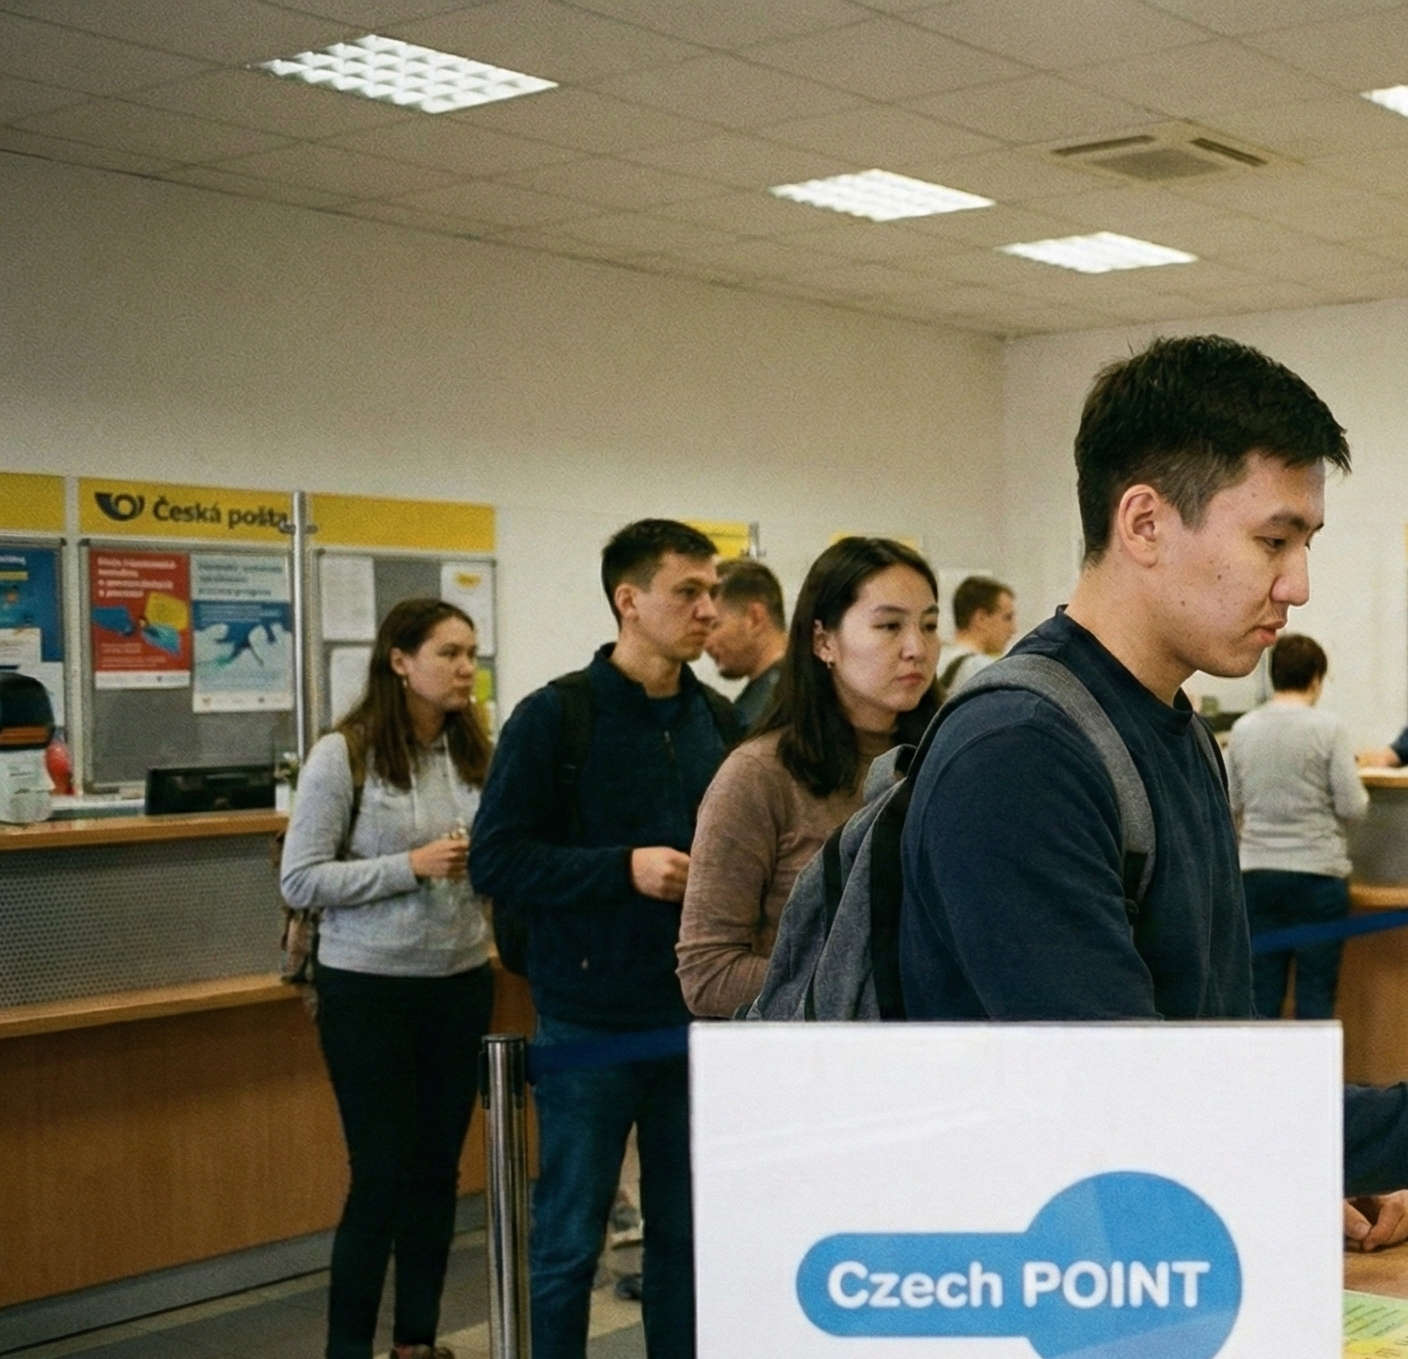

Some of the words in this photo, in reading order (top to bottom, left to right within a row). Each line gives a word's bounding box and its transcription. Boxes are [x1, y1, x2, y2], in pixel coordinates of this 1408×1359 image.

[153, 496, 221, 523] Česká
[828, 1260, 1003, 1309] Czech
[1023, 1260, 1210, 1309] POINT
